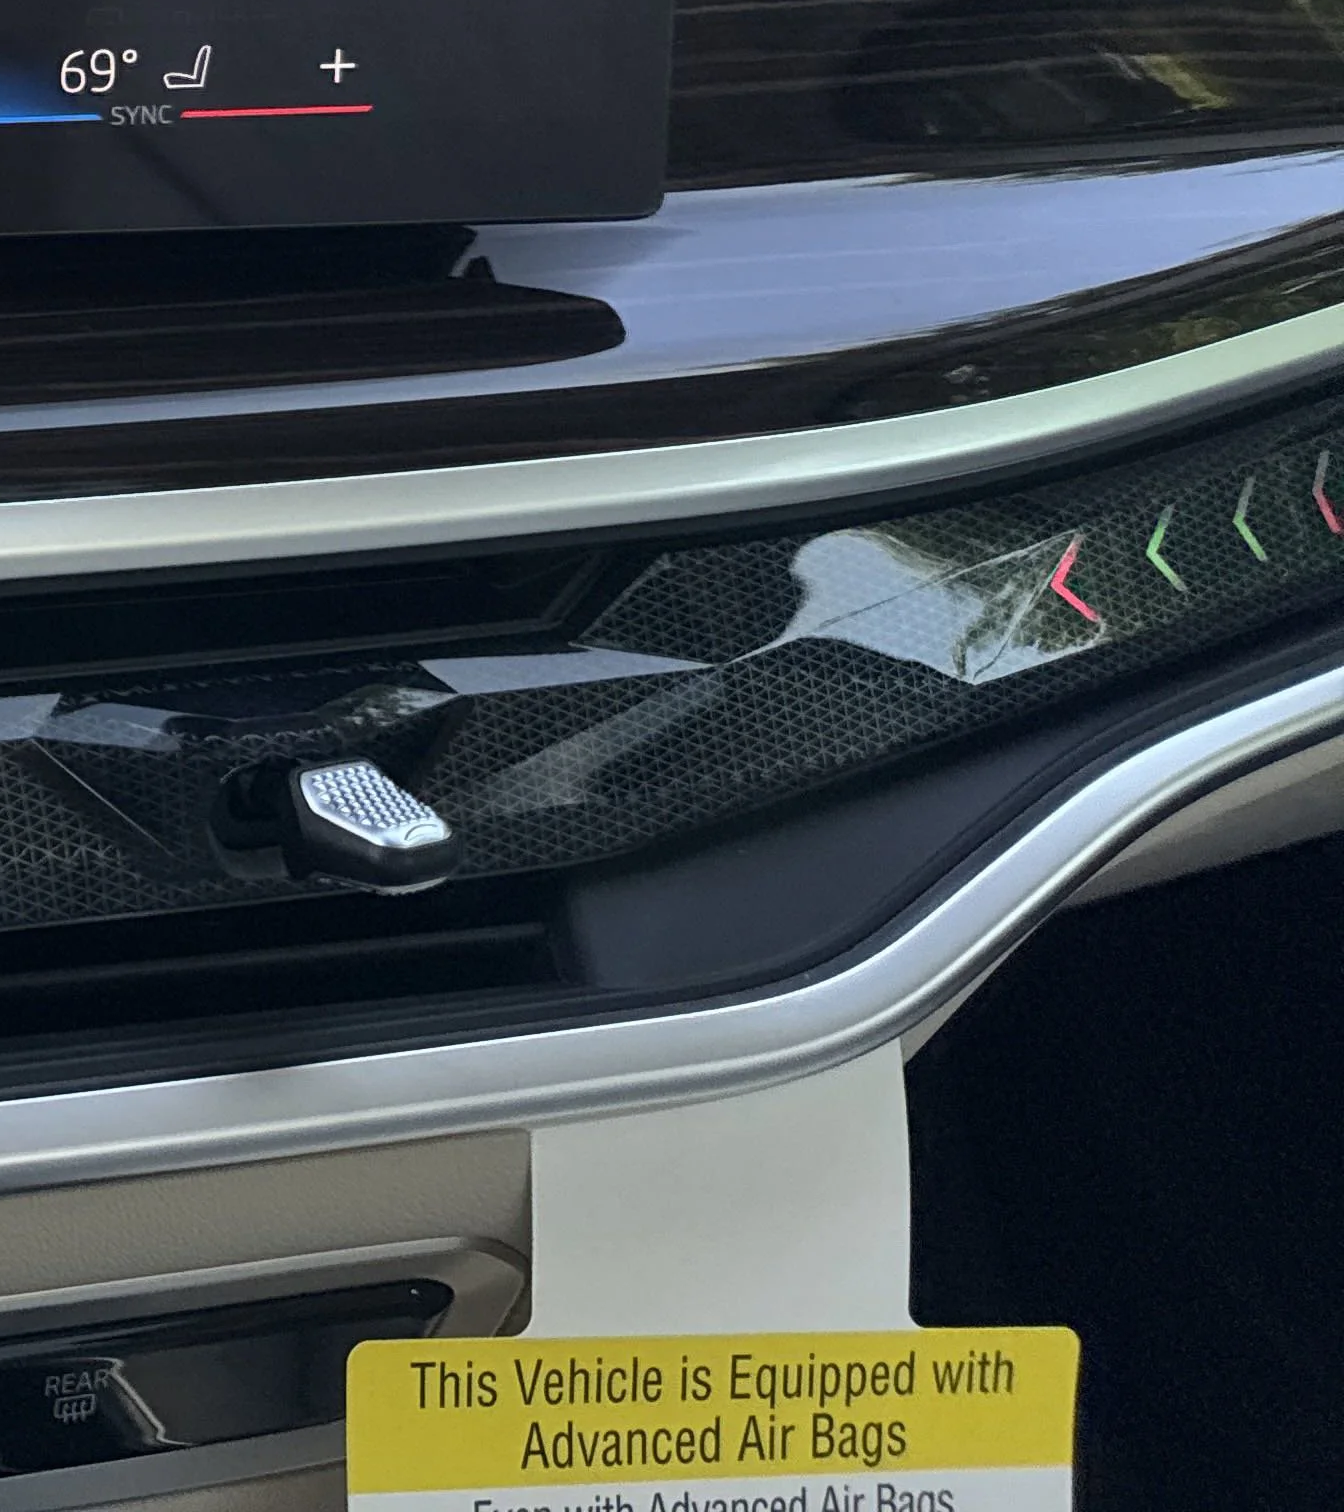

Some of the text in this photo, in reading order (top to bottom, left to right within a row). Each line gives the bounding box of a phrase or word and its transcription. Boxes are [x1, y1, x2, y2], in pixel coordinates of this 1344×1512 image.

[60, 47, 139, 95] 69°
[110, 104, 174, 127] SYNC
[44, 1368, 112, 1398] REAR
[411, 1347, 1015, 1410] This Vehicle is Equipped with
[520, 1414, 907, 1470] Advanced Air Bags
